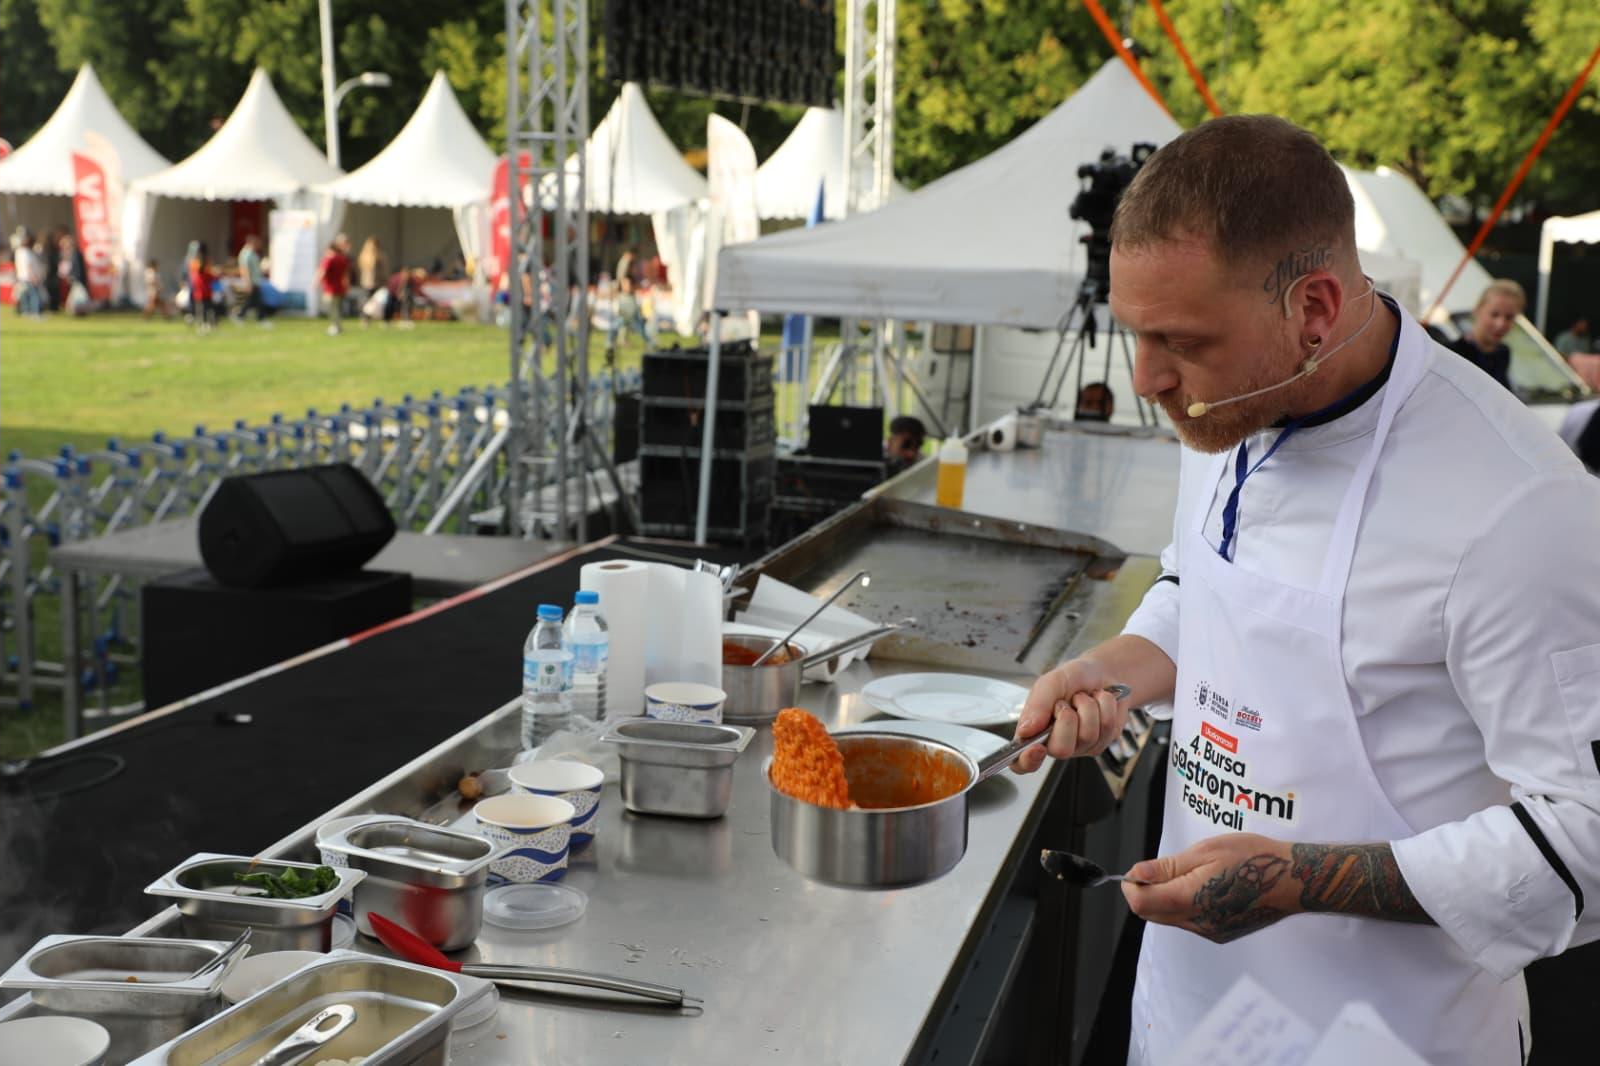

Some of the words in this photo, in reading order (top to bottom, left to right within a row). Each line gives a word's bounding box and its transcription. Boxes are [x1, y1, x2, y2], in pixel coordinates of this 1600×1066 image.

[1171, 740, 1295, 820] Gastronomi
[1189, 735, 1201, 756] 4.
[1203, 740, 1246, 778] Bursa
[1182, 783, 1244, 831] Festivali
